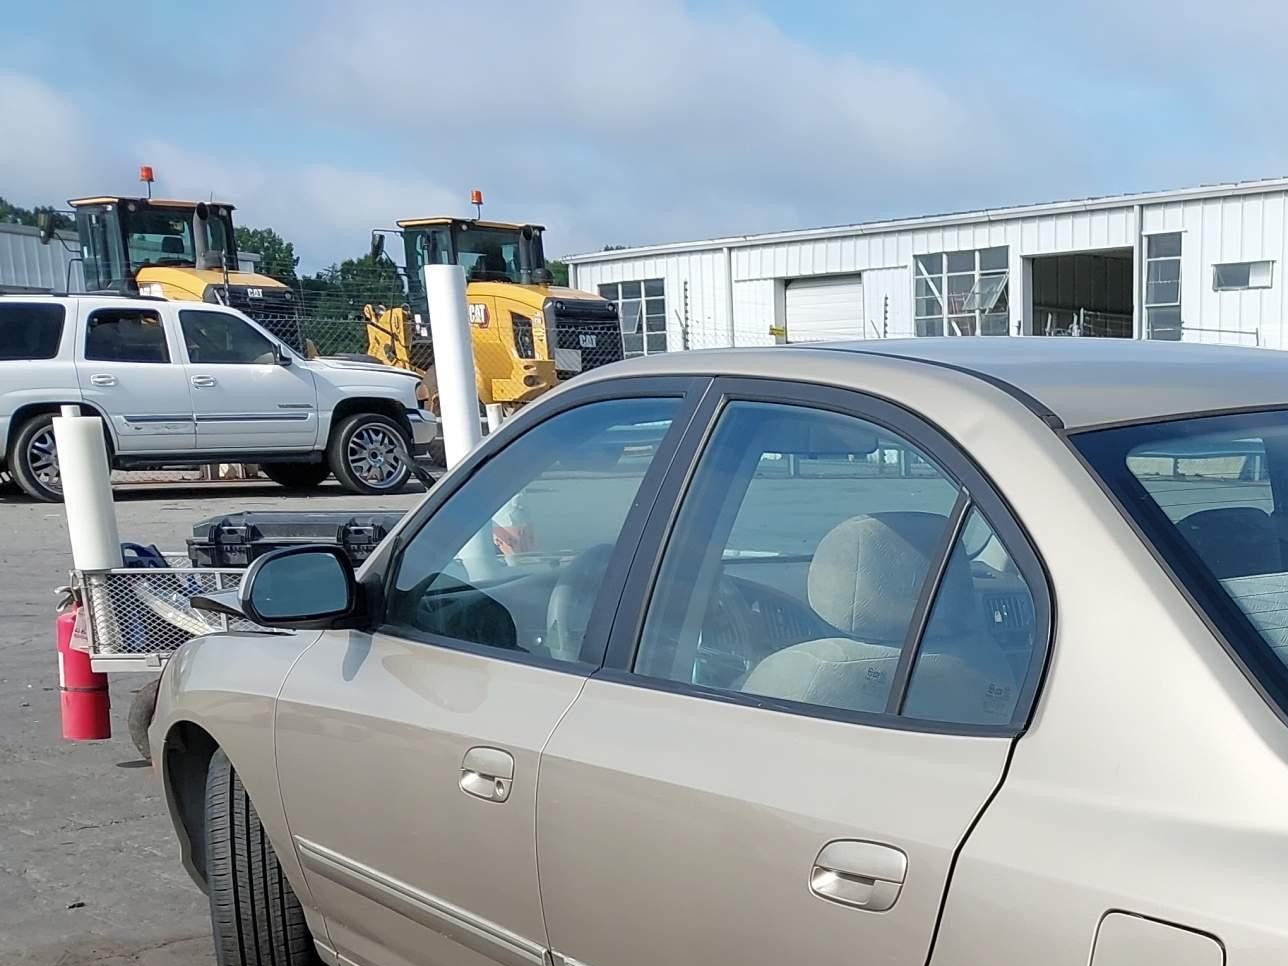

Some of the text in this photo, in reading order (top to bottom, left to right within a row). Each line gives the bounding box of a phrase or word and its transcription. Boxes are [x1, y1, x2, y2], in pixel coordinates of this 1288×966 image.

[247, 288, 263, 298] CAT
[468, 303, 486, 324] CAT
[578, 334, 597, 348] CAT
